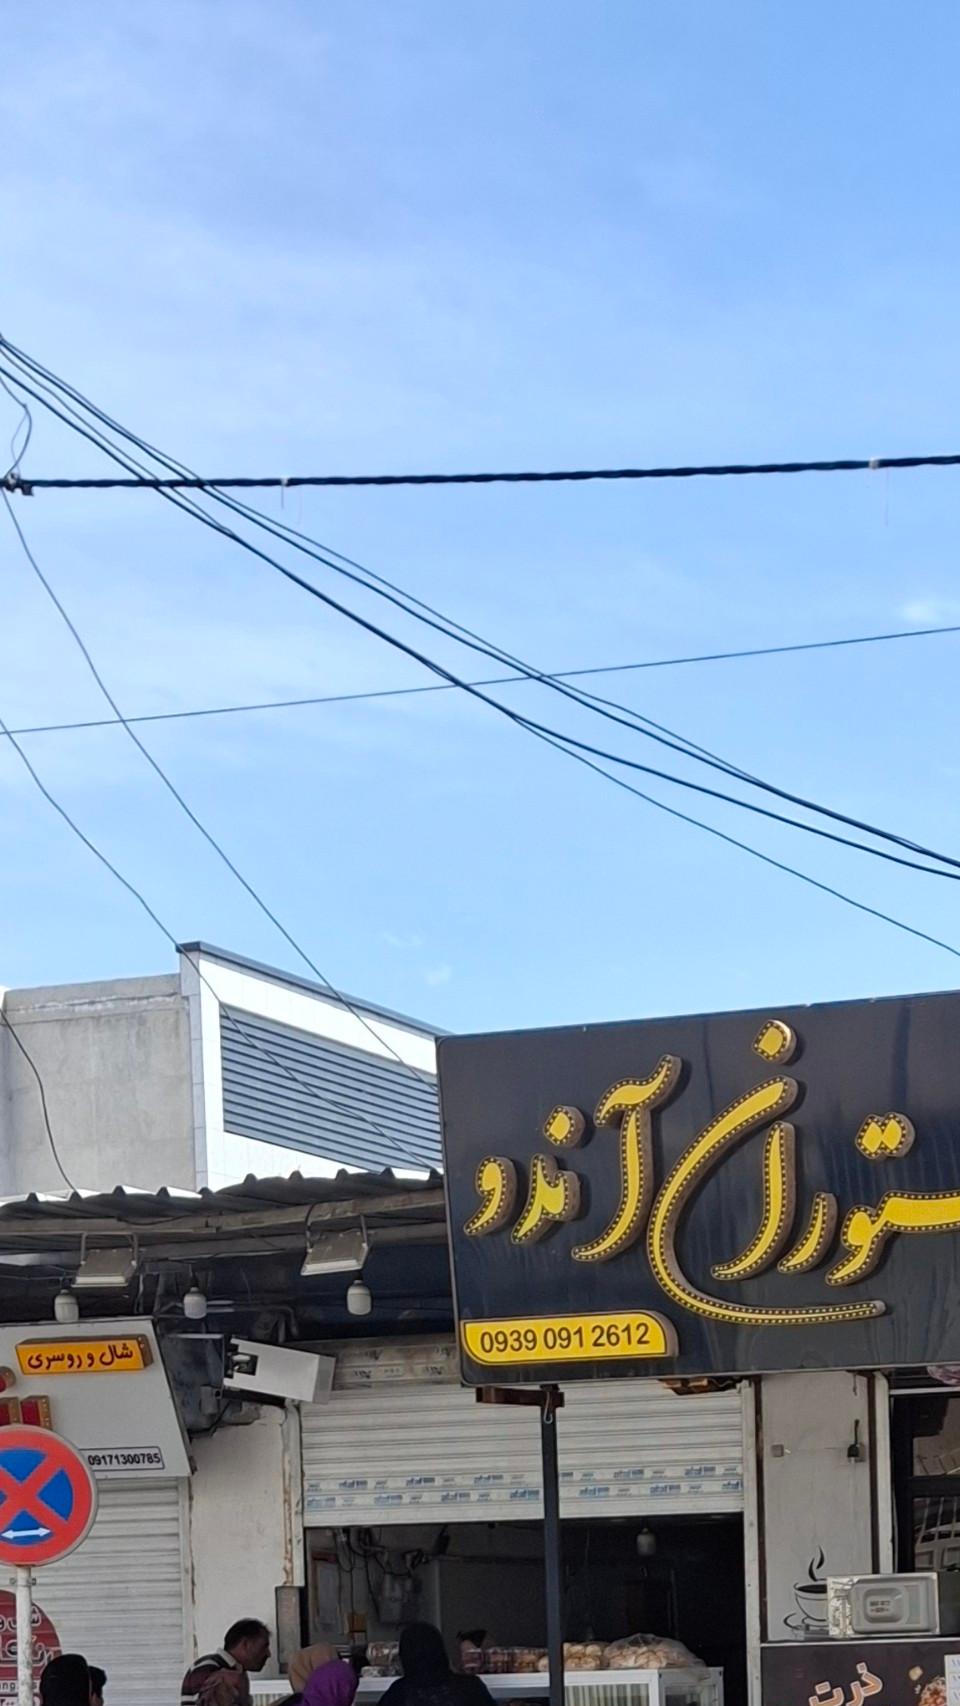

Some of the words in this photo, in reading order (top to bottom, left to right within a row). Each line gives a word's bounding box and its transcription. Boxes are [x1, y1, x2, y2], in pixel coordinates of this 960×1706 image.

[479, 1329, 538, 1353] 0939
[541, 1326, 585, 1350] 091
[590, 1321, 651, 1349] 2612
[27, 1352, 83, 1370] روسری
[87, 1354, 95, 1368] و
[99, 1343, 134, 1366] شال
[87, 1452, 162, 1466] 09171300785
